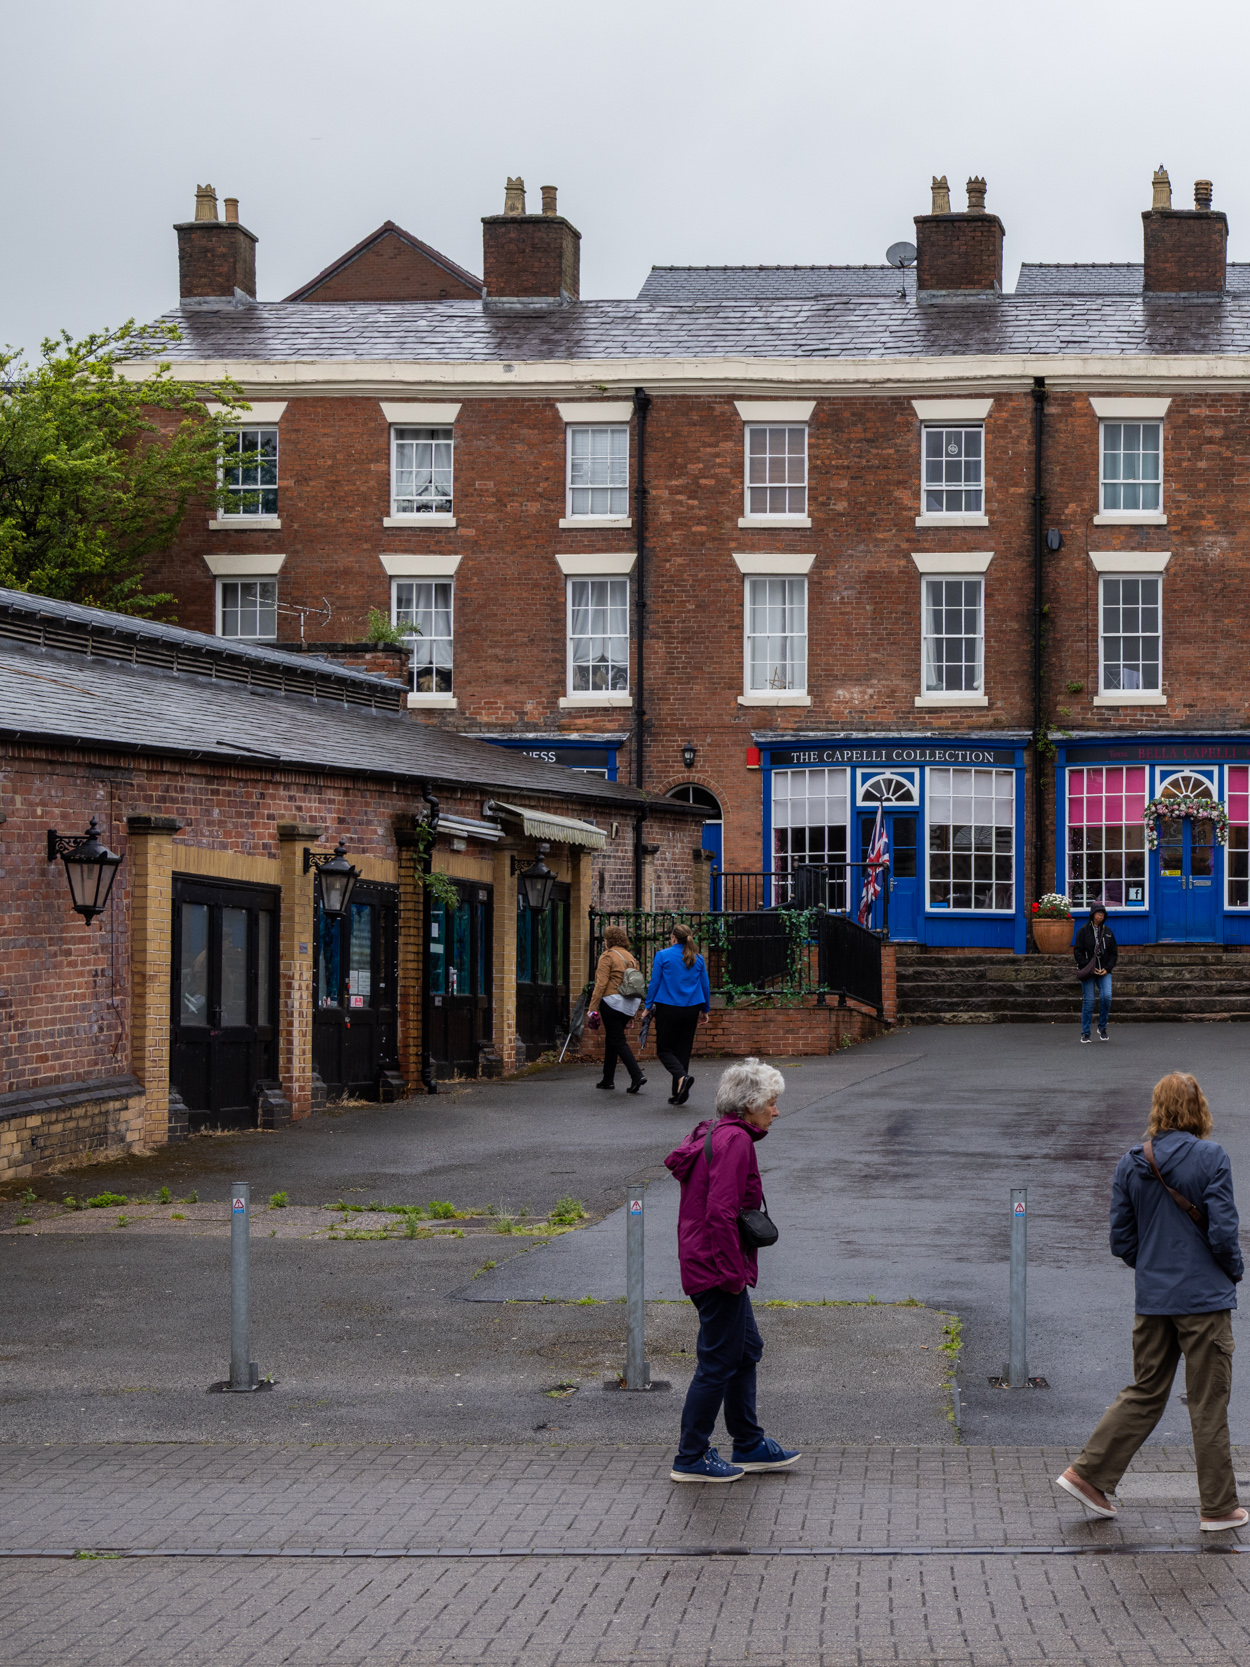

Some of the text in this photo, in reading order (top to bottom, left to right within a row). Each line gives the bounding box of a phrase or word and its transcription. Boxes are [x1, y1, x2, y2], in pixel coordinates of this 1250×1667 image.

[791, 750, 994, 763] THE CAPELLI COLLECTION
[1138, 747, 1236, 759] BELLA CAPELLI
